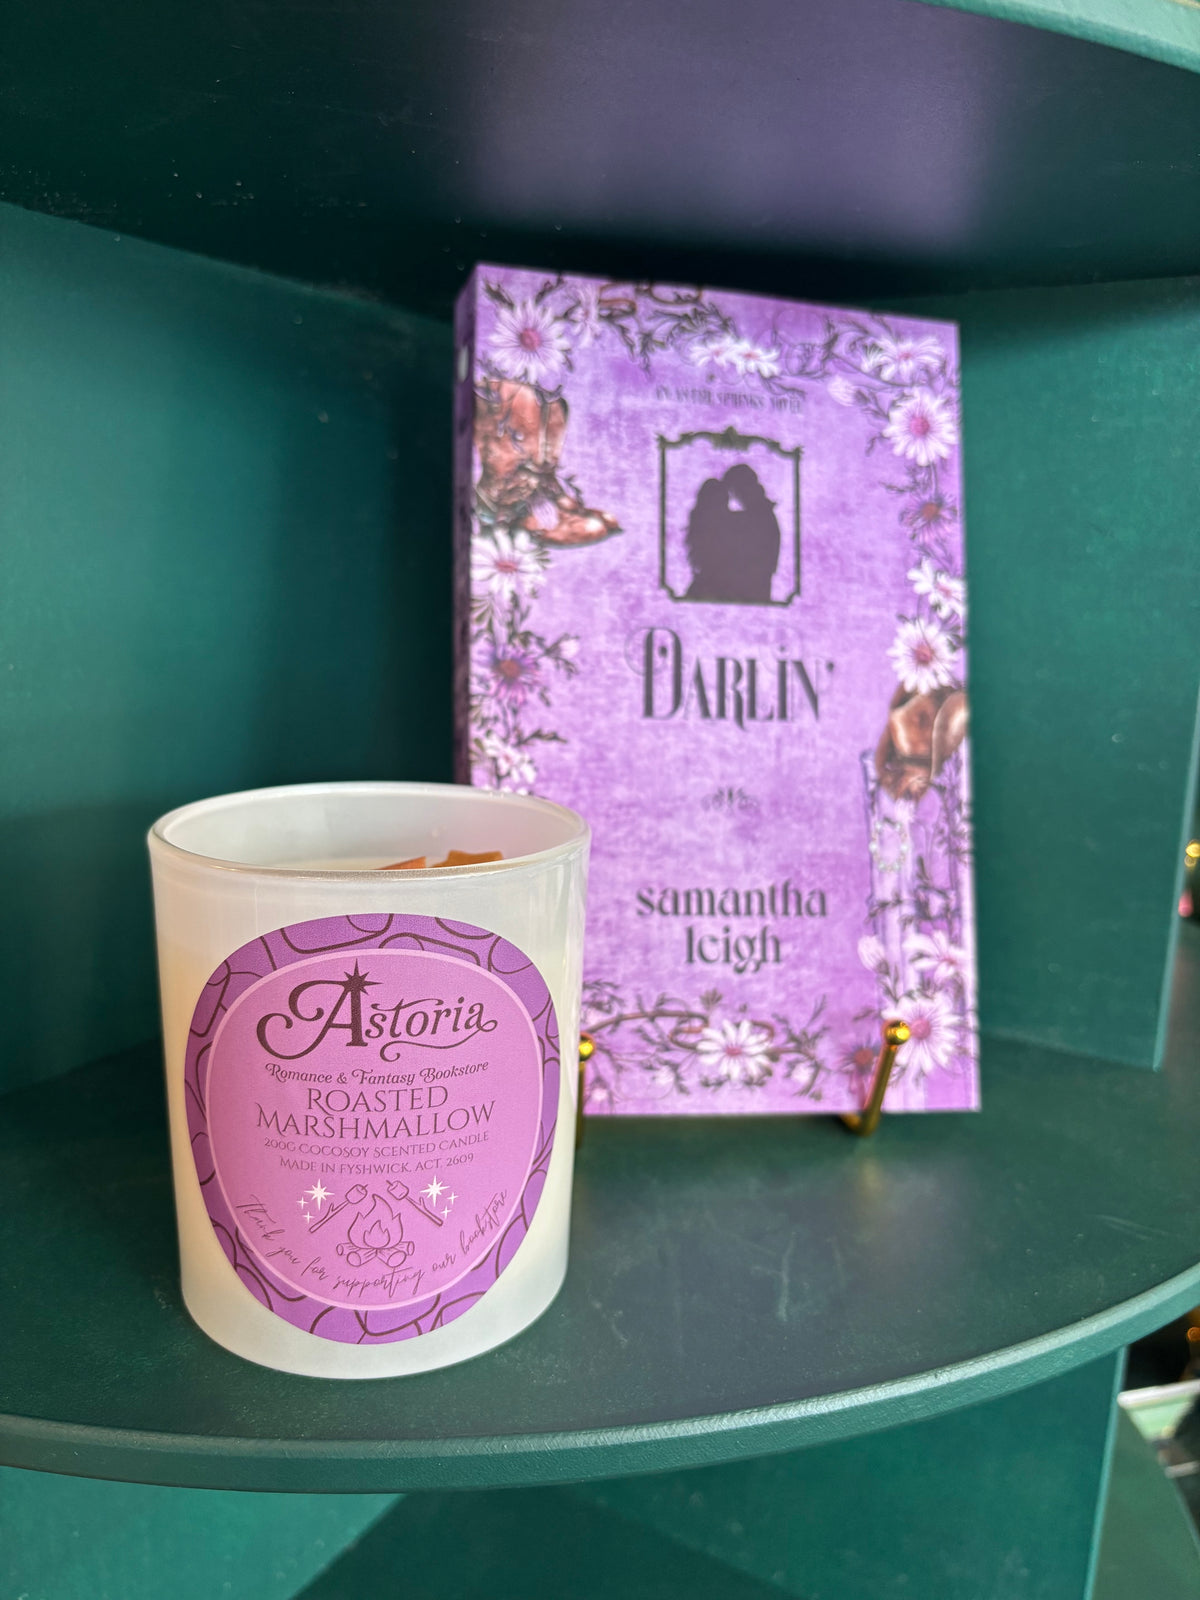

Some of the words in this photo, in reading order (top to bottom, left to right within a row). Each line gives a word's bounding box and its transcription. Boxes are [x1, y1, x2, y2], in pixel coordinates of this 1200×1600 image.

[636, 878, 827, 917] samantha
[685, 925, 782, 975] leigh
[256, 958, 498, 1062] Astoria
[265, 1062, 333, 1083] Romance
[336, 1072, 348, 1085] &
[351, 1068, 416, 1086] Fantasy
[419, 1061, 489, 1083] Bookstore
[254, 1100, 496, 1139] MARSHMALLOW
[307, 1085, 448, 1116] ROASTED
[264, 1137, 296, 1152] 200G
[299, 1143, 370, 1158] COCOSOY
[373, 1142, 436, 1159] SCENTED
[438, 1130, 489, 1151] CANDLE
[280, 1155, 317, 1172] MADE
[321, 1162, 336, 1173] IN
[446, 1152, 474, 1168] 2609
[235, 1193, 286, 1242] Thank
[264, 1246, 302, 1265] you
[300, 1255, 329, 1281] for
[332, 1265, 426, 1299] supporting
[431, 1252, 457, 1272] our
